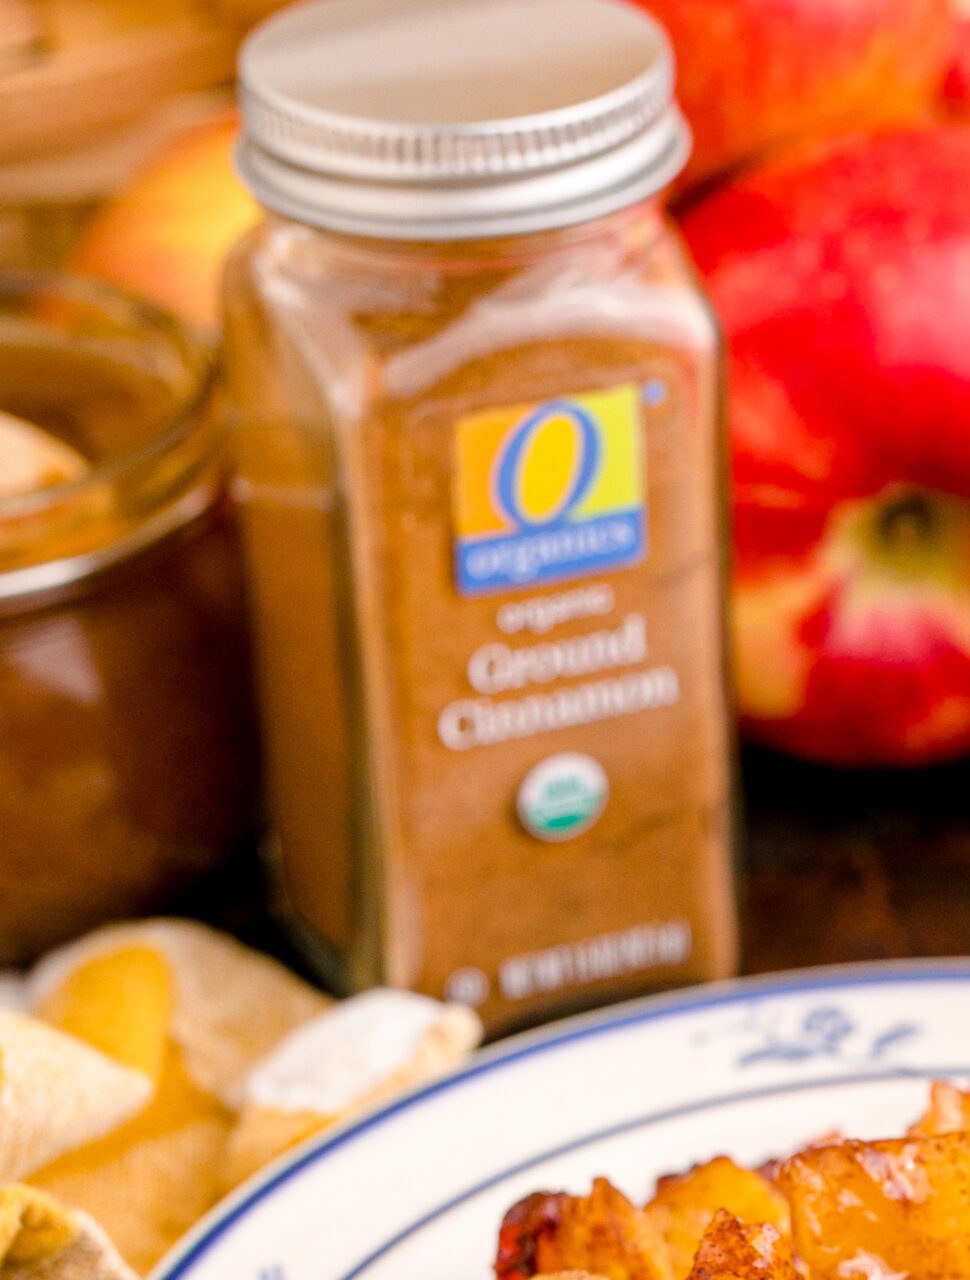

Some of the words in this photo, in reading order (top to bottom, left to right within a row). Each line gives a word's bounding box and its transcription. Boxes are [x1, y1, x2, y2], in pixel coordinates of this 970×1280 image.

[465, 518, 637, 583] organics
[467, 614, 647, 694] Ground
[438, 667, 679, 750] Cinnamon
